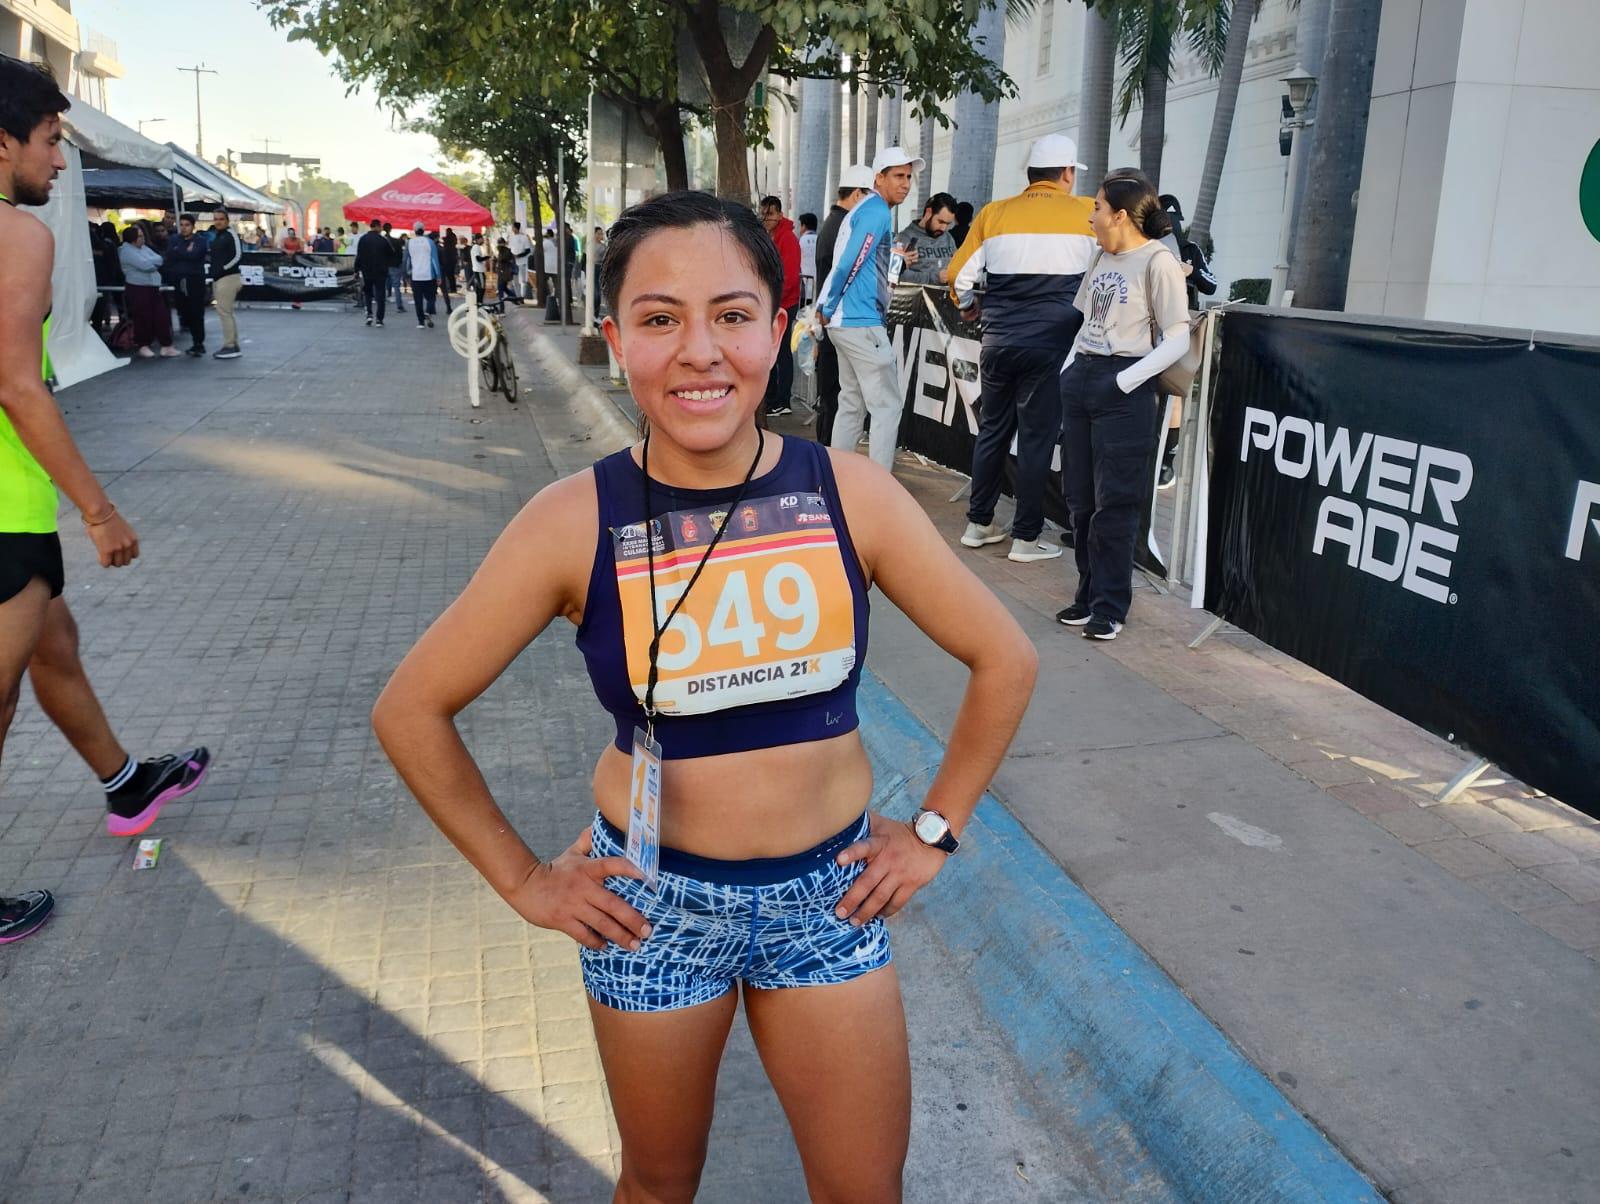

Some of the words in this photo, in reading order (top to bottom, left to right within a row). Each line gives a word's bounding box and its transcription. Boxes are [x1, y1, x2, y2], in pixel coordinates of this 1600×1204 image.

[278, 266, 338, 278] POWER
[847, 235, 875, 284] BANORTE
[305, 277, 338, 288] ADE
[1092, 271, 1128, 304] NTATHLON
[1240, 406, 1474, 527] POWER
[780, 496, 798, 508] KD
[1312, 495, 1460, 604] ADE
[650, 561, 820, 672] 549
[687, 665, 785, 696] DISTANCIA
